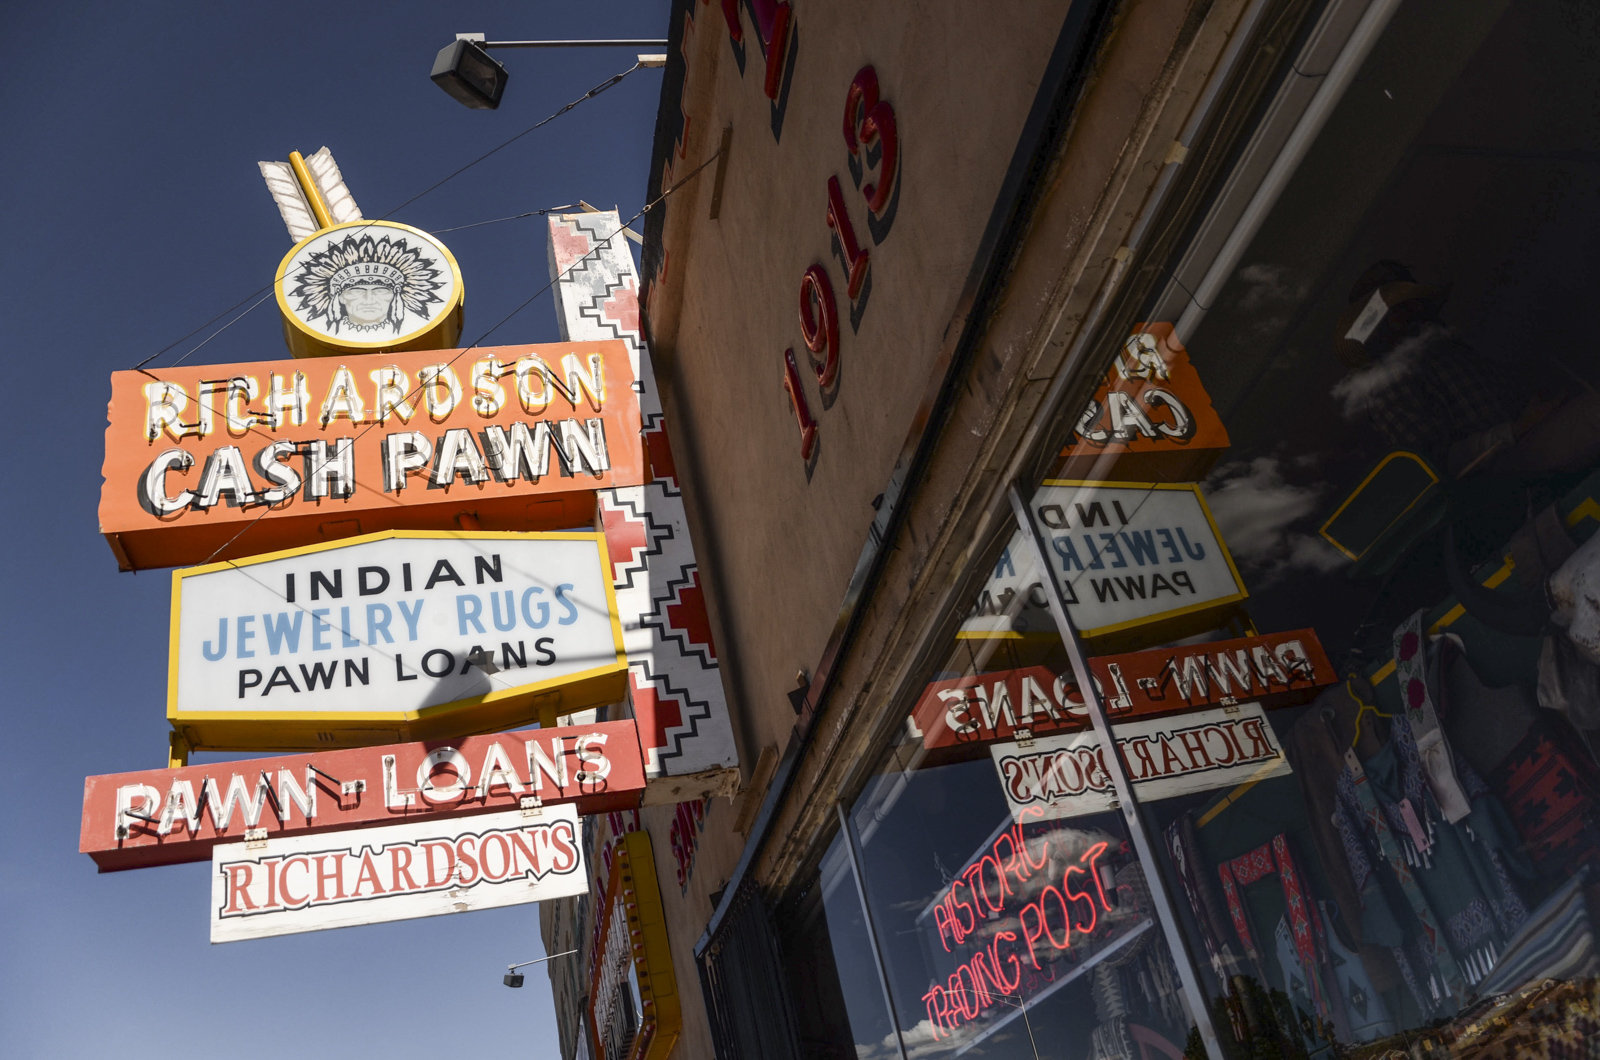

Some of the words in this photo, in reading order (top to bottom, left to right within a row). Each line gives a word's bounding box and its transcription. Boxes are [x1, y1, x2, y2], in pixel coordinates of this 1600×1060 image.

[784, 65, 899, 460] 1913
[142, 352, 608, 440] RICHARDSON
[138, 435, 356, 516] CASH
[382, 417, 612, 494] PAWN
[202, 598, 425, 663] JEWELRY
[457, 582, 580, 636] RUGS
[286, 554, 504, 602] INDIAN
[237, 657, 371, 699] PAWN
[395, 637, 558, 682] LOANS
[115, 764, 316, 843] PAWN
[381, 733, 611, 810] LOANS
[222, 825, 577, 914] RICHARDSON'S
[933, 805, 1049, 953] HISTORIC
[921, 931, 1020, 1042] TRADING
[1018, 841, 1112, 971] POST
